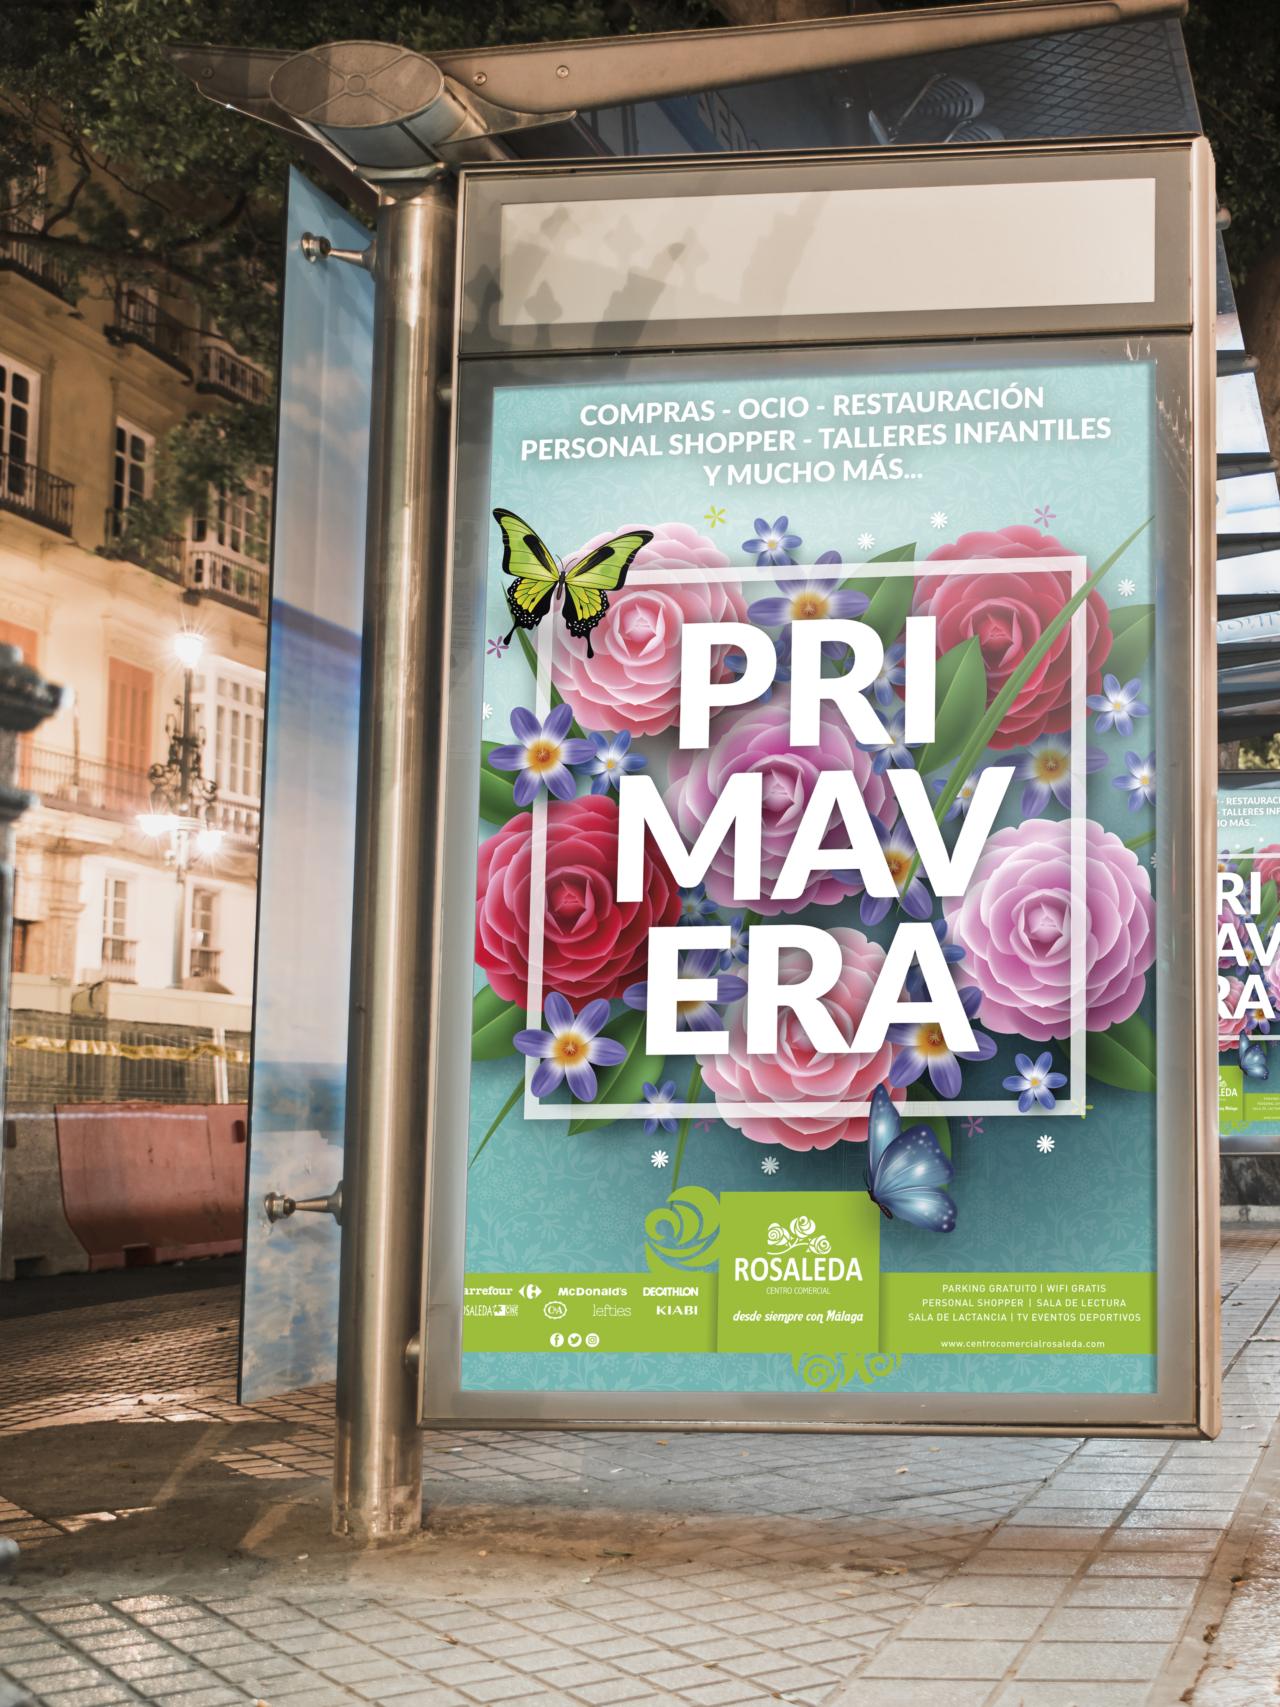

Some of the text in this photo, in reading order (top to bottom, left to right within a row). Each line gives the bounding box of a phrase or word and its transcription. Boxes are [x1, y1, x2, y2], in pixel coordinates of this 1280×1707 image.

[579, 399, 715, 427] COMPRAS
[738, 396, 810, 421] OCIO
[833, 382, 1044, 418] RESTAURACIÓN
[521, 434, 662, 462] PERSONAL
[668, 429, 796, 456] SHOPPER
[818, 423, 947, 450] TALLERES
[955, 416, 1112, 445] INFANTILES
[703, 453, 923, 487] Y MUCHO MÁS...
[678, 615, 937, 749] PRI
[1222, 808, 1264, 816] TALLERES
[616, 765, 1016, 903] MAV
[645, 921, 980, 1055] ERA
[734, 1256, 864, 1282] ROSALEDA
[463, 1286, 513, 1296] arrefour
[557, 1286, 628, 1297] McDonald's
[642, 1286, 699, 1297] DECATHLON
[766, 1286, 832, 1295] CENTRO COMERCIAL
[942, 1284, 986, 1293] PARKING
[989, 1284, 1037, 1293] GRATUITO
[1046, 1284, 1068, 1293] WIFI
[1071, 1284, 1107, 1293] GRATIS
[922, 1298, 974, 1307] PERSONAL
[977, 1298, 1024, 1307] SHOPPER
[1036, 1298, 1061, 1307] SALA
[1065, 1298, 1078, 1307] DE
[1081, 1298, 1127, 1307] LECTURA
[592, 1304, 632, 1317] lefties
[656, 1305, 698, 1316] KIABI
[732, 1309, 864, 1324] desde siempre con Málaga
[907, 1313, 934, 1322] SALA
[936, 1313, 950, 1322] DE
[952, 1313, 1007, 1322] LACTANCIA
[1017, 1313, 1029, 1322] TV
[1031, 1313, 1076, 1322] EVENTOS
[1079, 1313, 1142, 1322] DEPORTIVOS
[940, 1339, 1105, 1349] www.centrocomercialrosaleda.com
